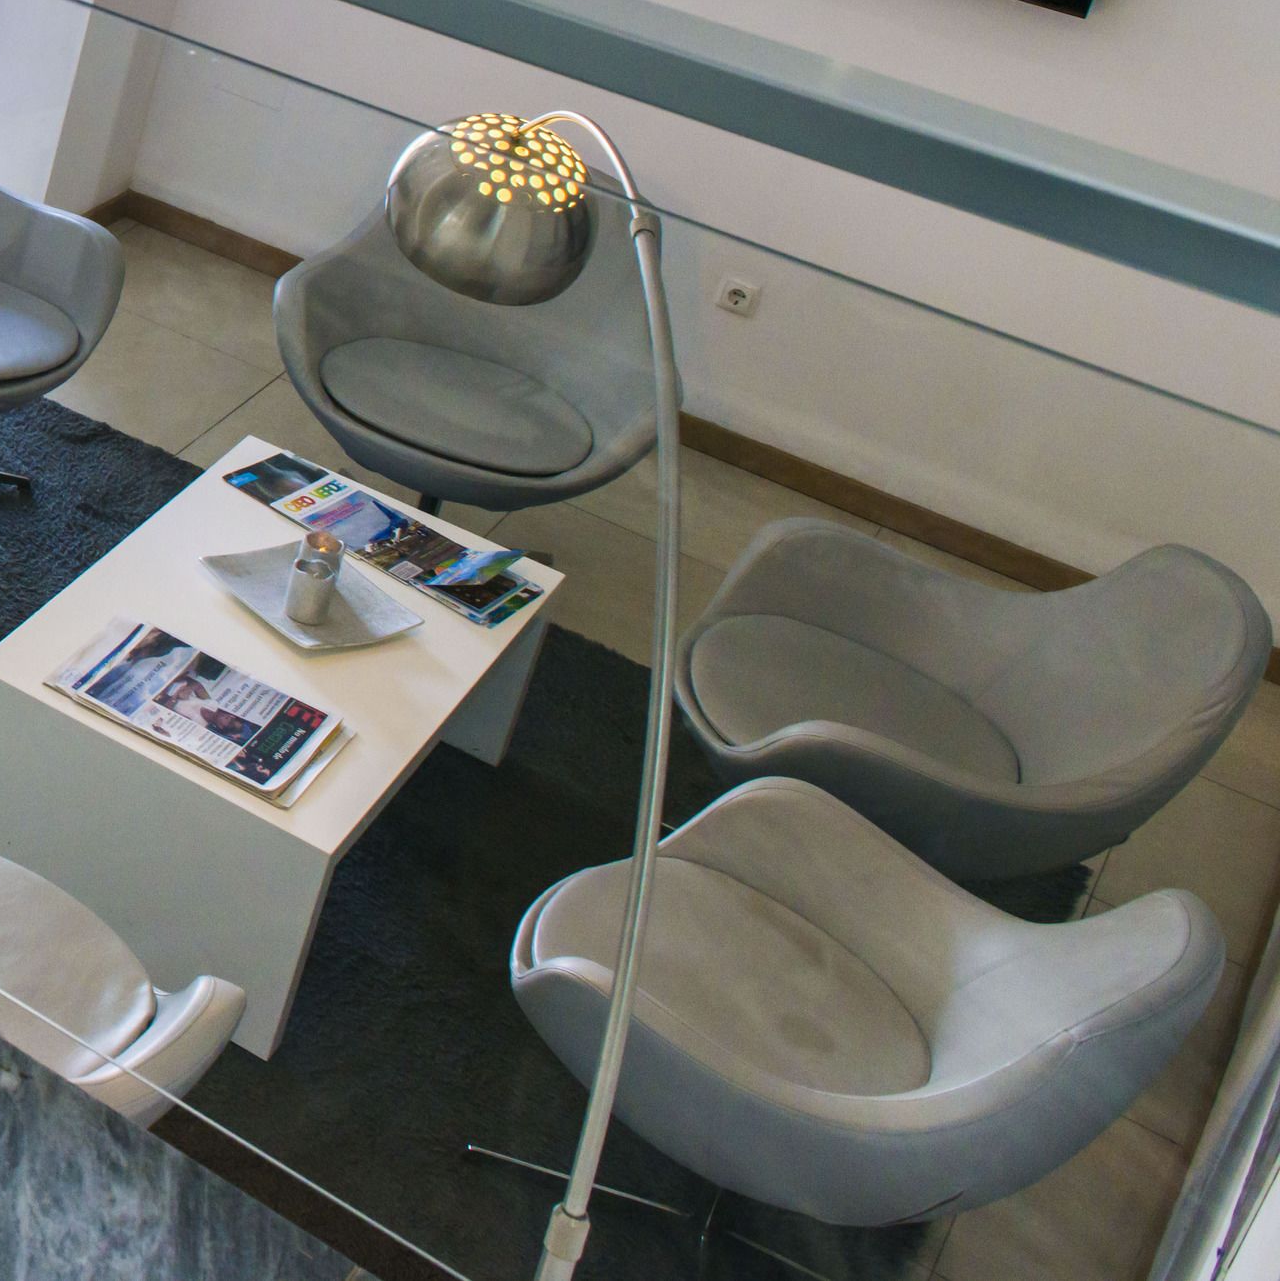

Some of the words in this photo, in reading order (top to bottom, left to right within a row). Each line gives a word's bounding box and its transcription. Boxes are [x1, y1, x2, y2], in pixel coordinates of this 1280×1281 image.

[282, 495, 316, 513] CABO
[309, 479, 348, 500] VERDE
[292, 727, 306, 737] No
[277, 735, 300, 754] mundo
[271, 752, 284, 761] de
